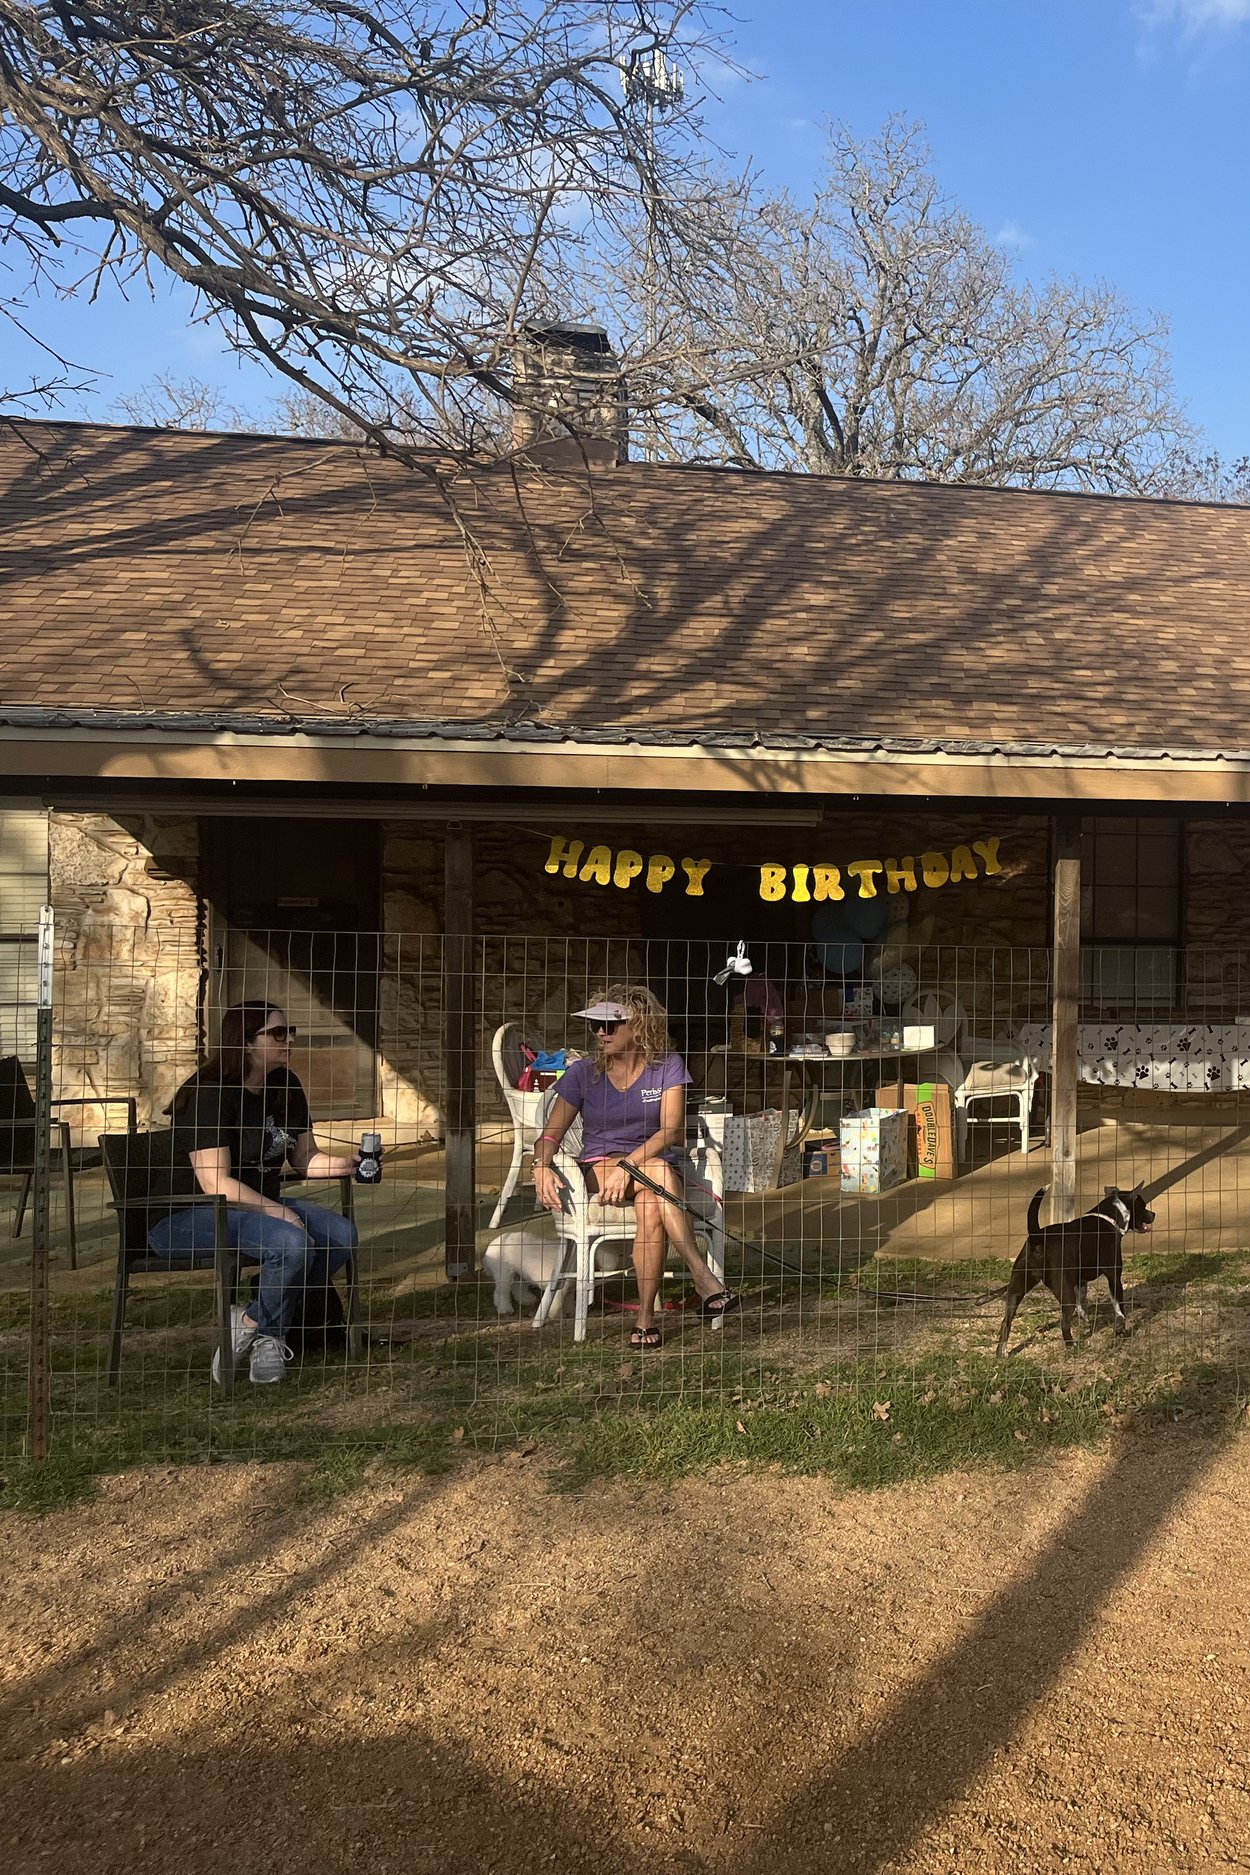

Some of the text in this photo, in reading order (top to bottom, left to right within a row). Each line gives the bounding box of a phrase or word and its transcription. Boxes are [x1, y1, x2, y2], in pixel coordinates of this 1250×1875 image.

[544, 836, 1001, 902] HAPPY BIRTHDAY
[922, 1105, 936, 1165] DOUBLEDAVE'S
